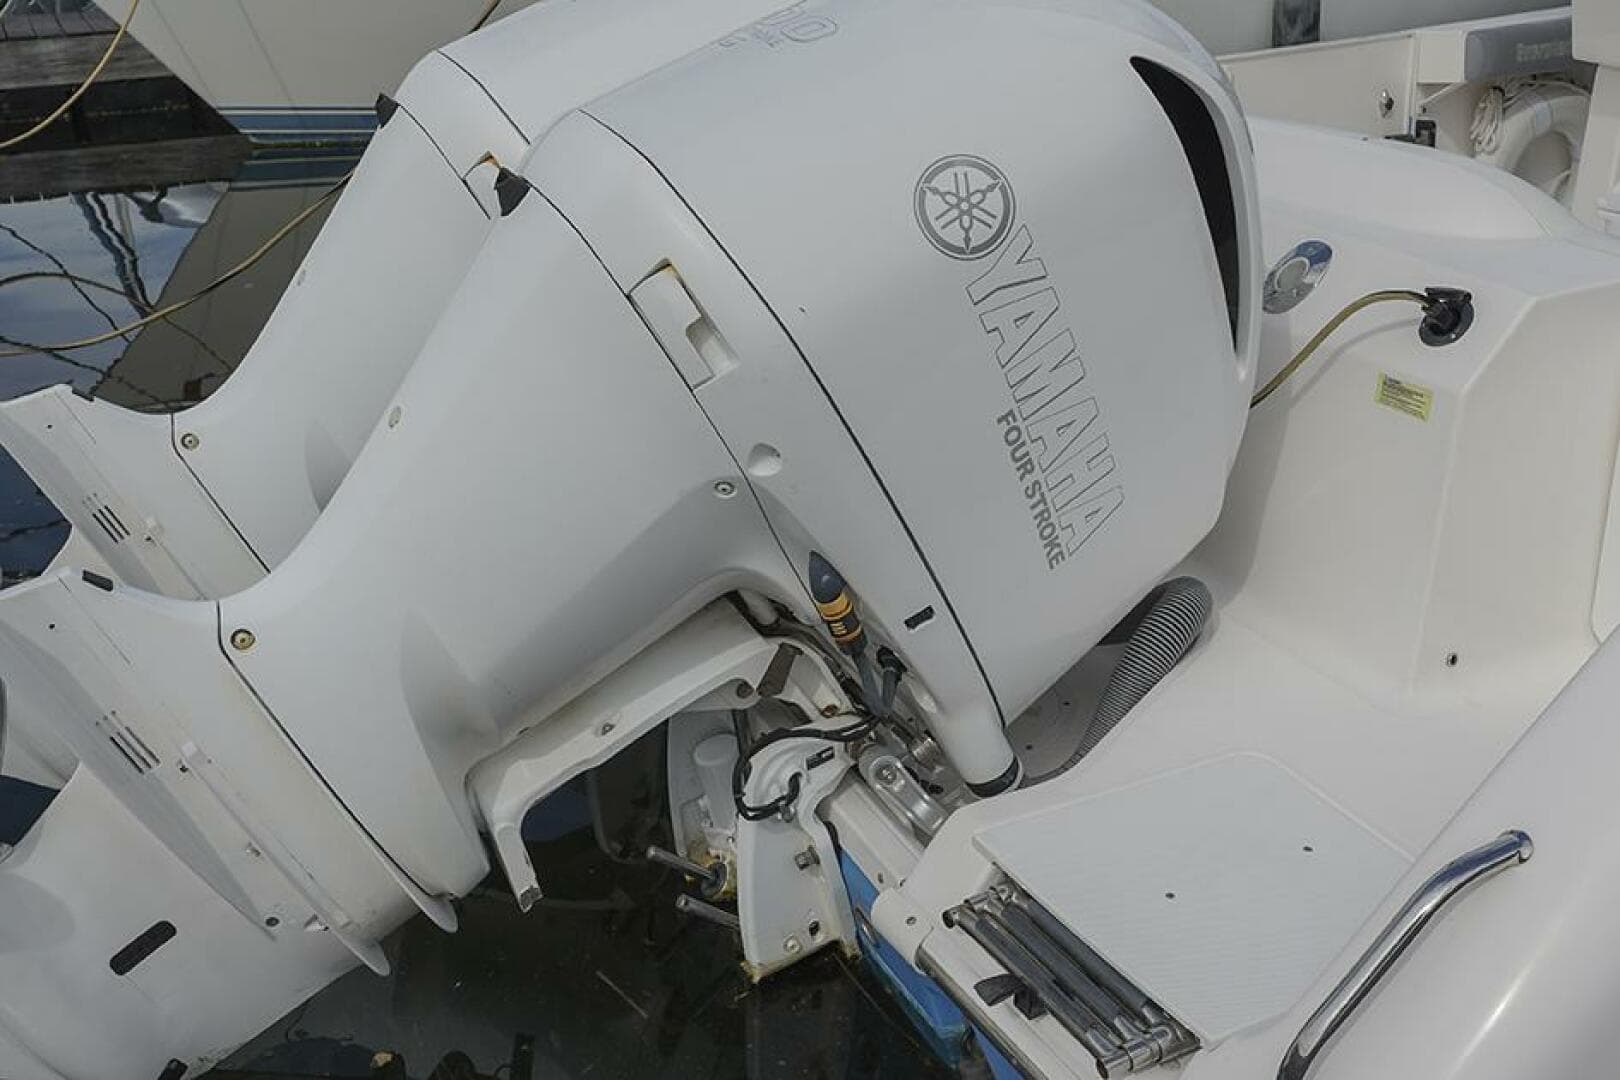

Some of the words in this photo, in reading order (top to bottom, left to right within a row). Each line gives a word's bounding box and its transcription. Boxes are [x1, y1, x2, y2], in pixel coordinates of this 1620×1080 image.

[965, 224, 1125, 556] YAMAHA
[997, 408, 1034, 481] FOUR
[1024, 479, 1065, 569] STROKE
